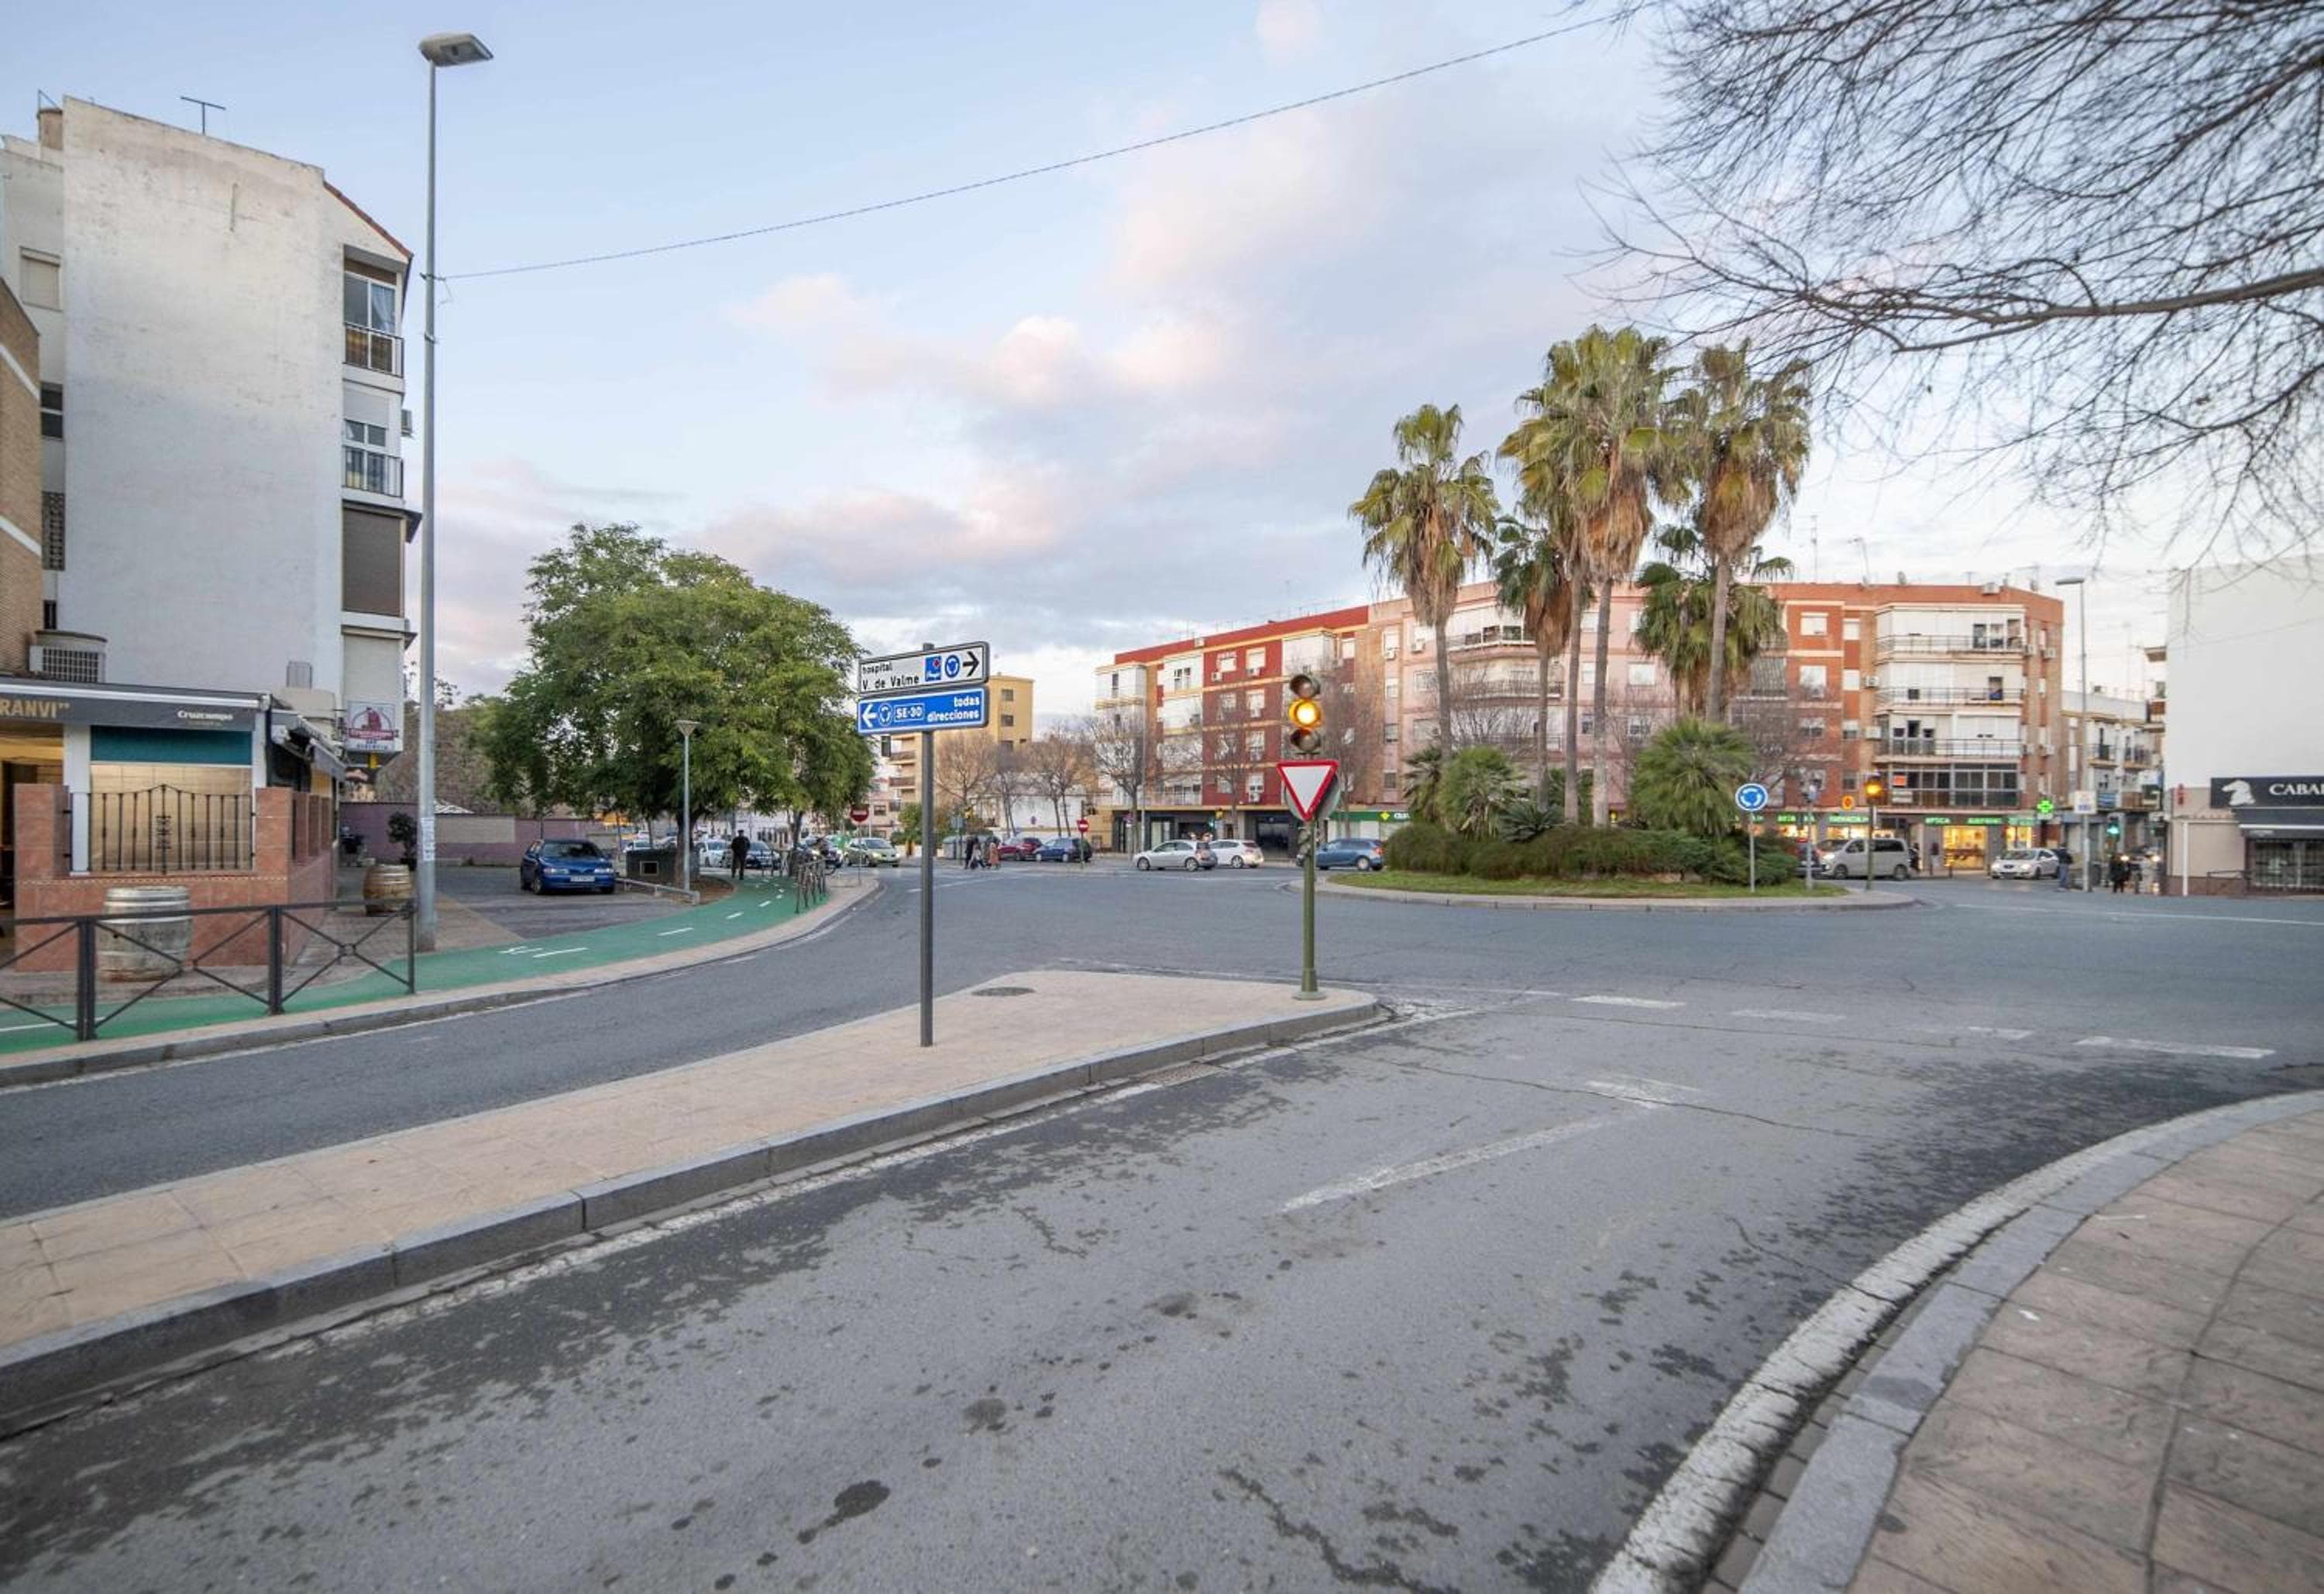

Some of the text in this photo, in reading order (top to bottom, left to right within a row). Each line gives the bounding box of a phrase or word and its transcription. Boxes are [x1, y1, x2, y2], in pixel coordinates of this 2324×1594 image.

[862, 661, 892, 675] hospital
[862, 675, 920, 690] V. de Valme
[954, 696, 980, 708] todas
[896, 706, 923, 719] SE-30
[927, 709, 980, 723] direcciones
